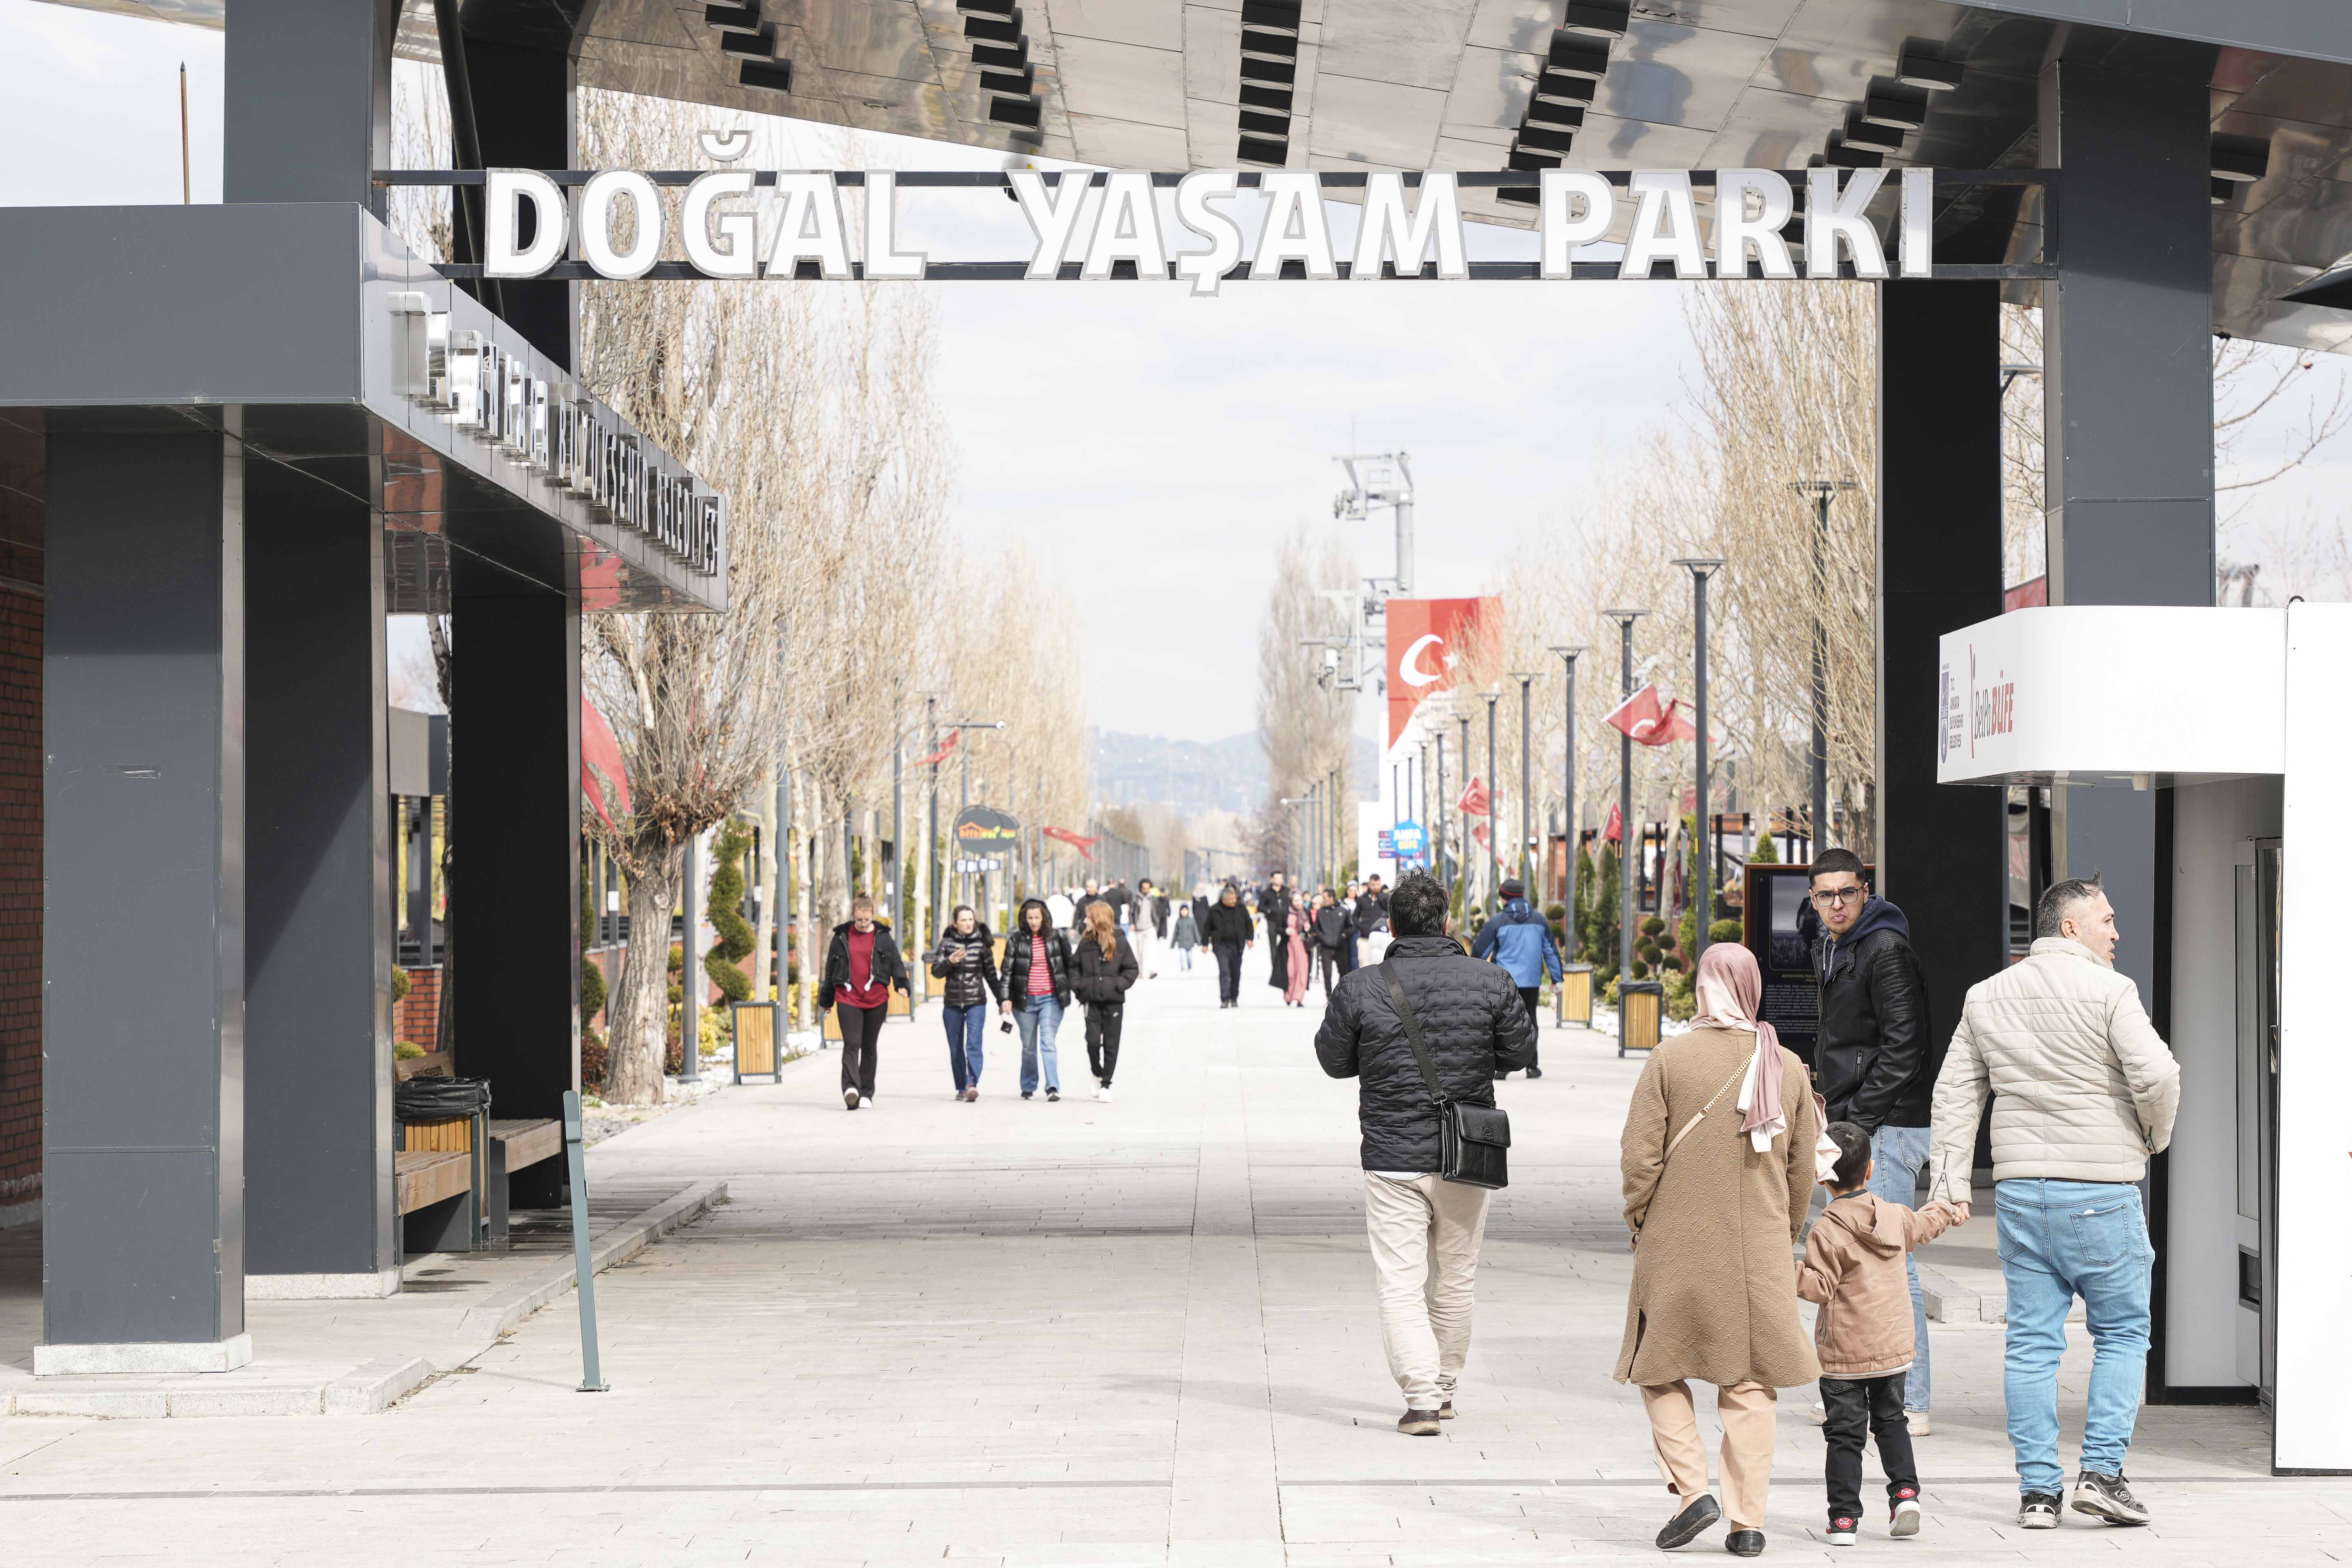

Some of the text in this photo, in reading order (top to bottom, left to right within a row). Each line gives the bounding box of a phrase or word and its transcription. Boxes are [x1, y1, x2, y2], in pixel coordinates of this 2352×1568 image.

[484, 130, 1933, 297] DOĞAL YAŞAM PARKI
[462, 330, 548, 471] ANKARA
[1950, 695, 1960, 710] ANKARA
